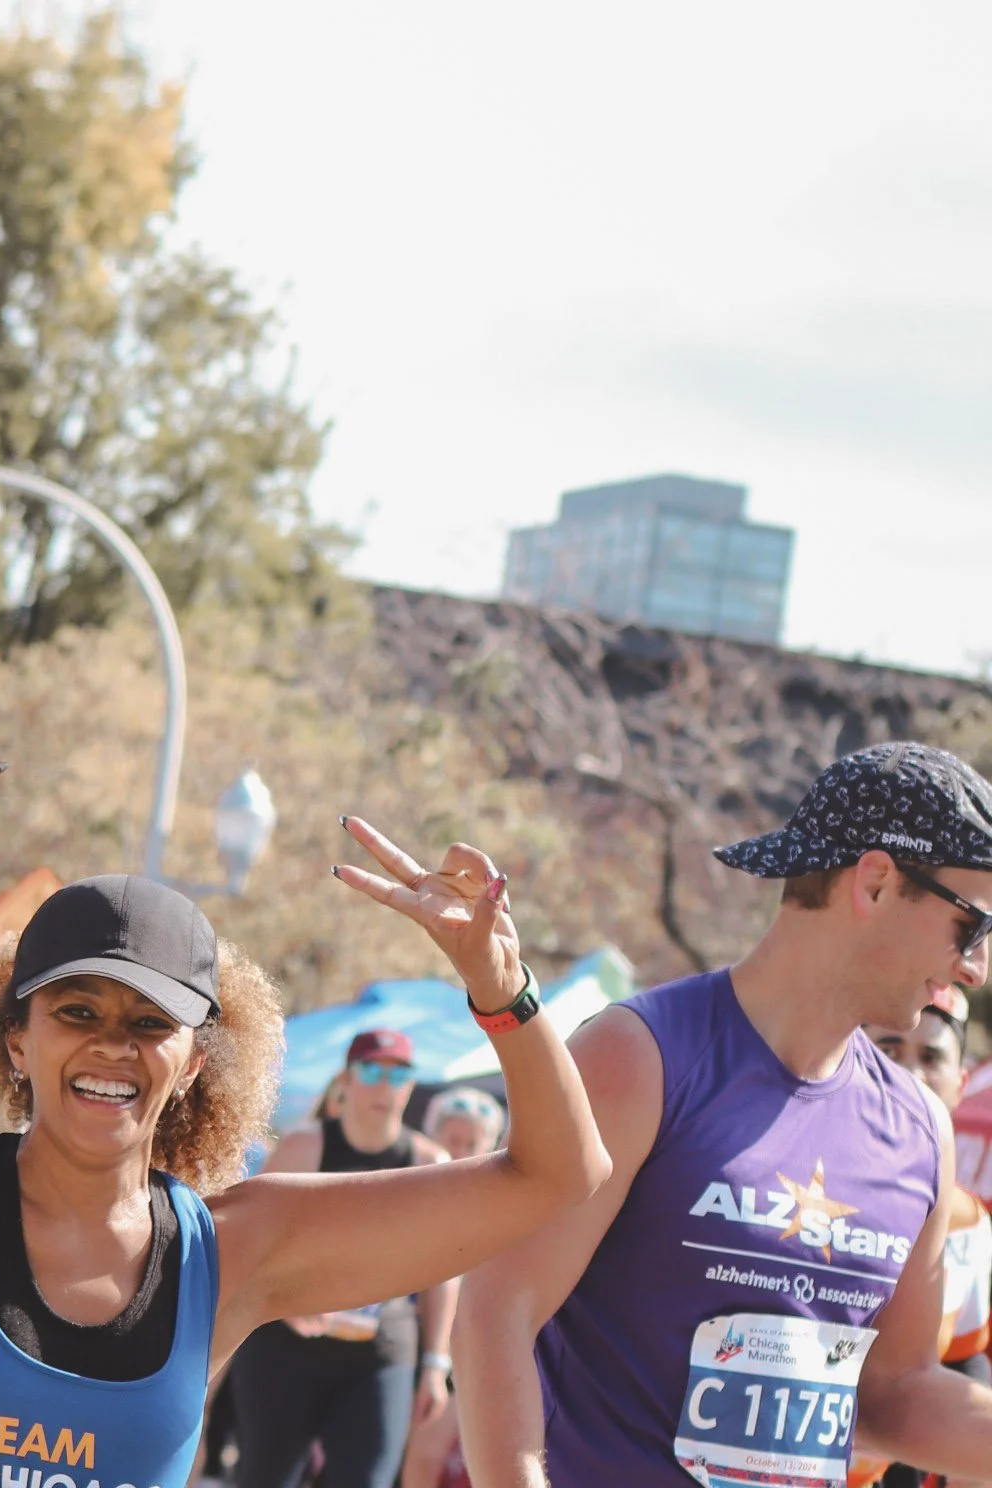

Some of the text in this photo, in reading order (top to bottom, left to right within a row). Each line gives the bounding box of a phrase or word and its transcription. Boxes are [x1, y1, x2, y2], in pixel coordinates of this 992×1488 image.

[882, 832, 933, 853] SPRINTS
[689, 1181, 795, 1230] ALZ
[799, 1208, 912, 1264] Stars
[705, 1264, 791, 1293] alzheimer's
[748, 1336, 791, 1353] Chicago
[748, 1350, 797, 1366] Marathon
[688, 1376, 855, 1448] C 11759
[745, 1454, 781, 1468] October
